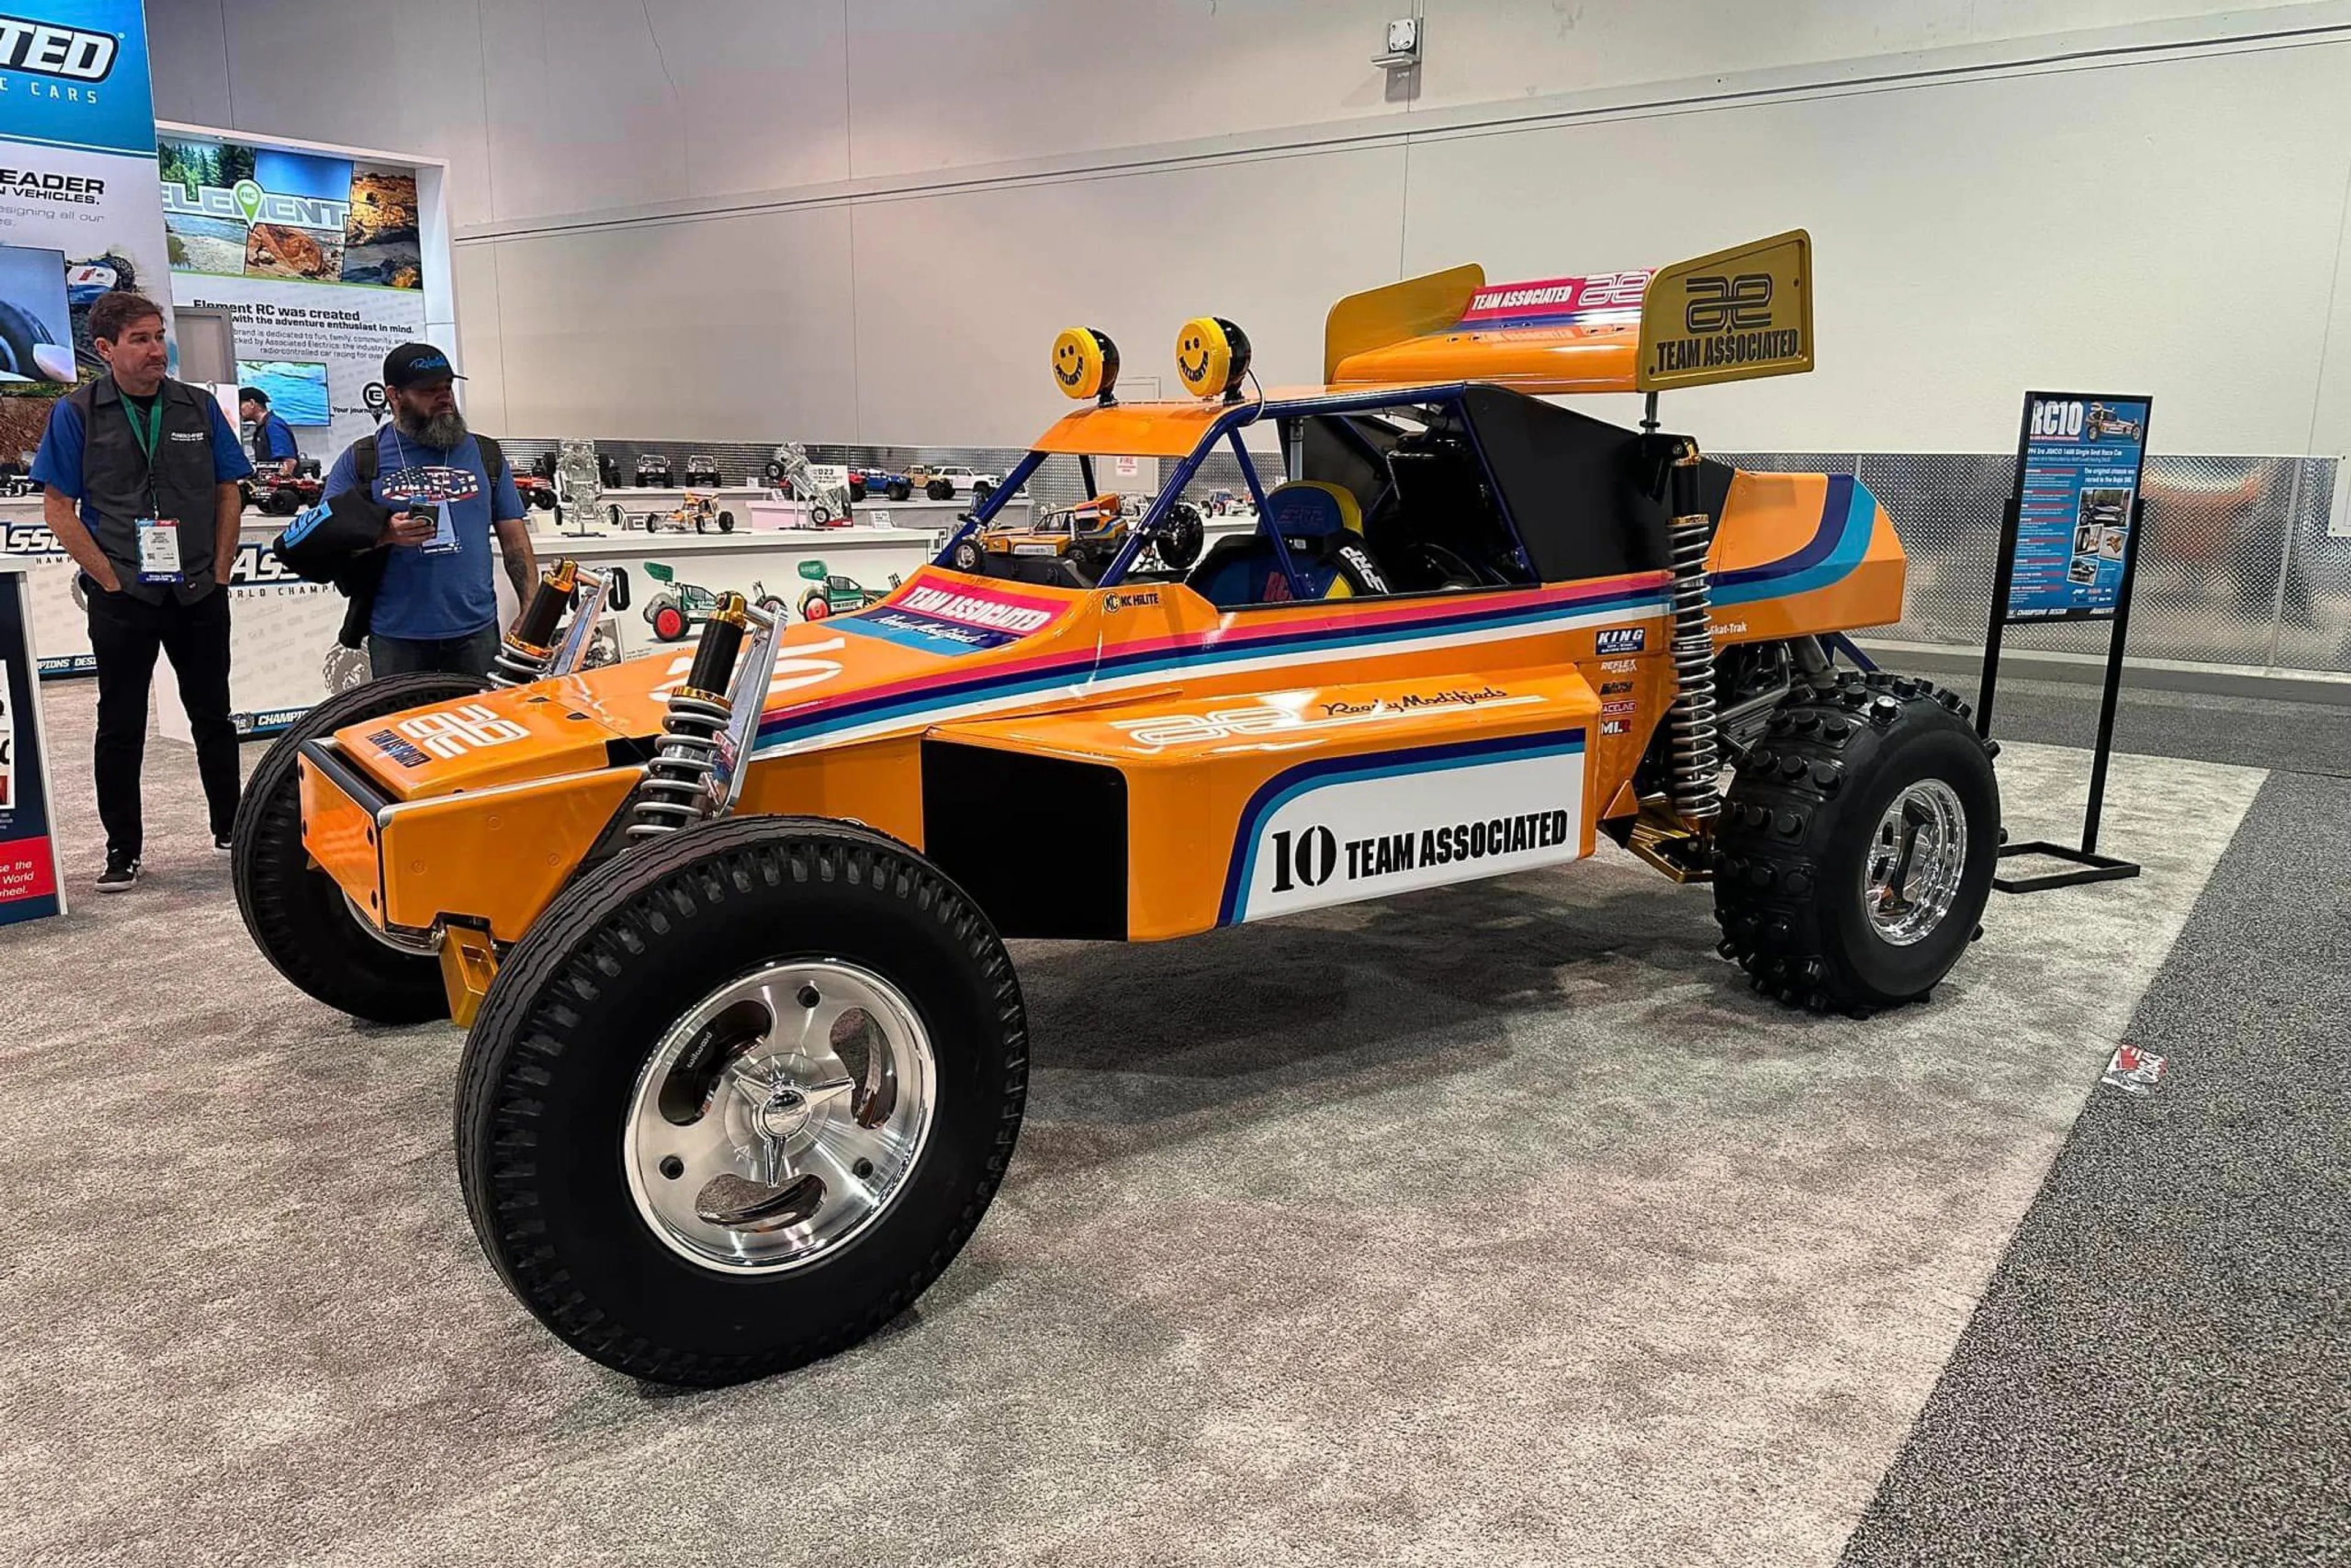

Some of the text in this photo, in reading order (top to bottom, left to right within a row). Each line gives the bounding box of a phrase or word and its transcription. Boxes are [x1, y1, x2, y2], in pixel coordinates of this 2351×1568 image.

[31, 82, 97, 103] CARS
[0, 168, 105, 195] EADER
[13, 187, 100, 205] VEHICLES.
[61, 211, 74, 220] all
[80, 214, 104, 223] our
[1471, 293, 1502, 310] TEAM
[1500, 286, 1573, 308] ASSOCIATED
[256, 304, 275, 315] RC
[278, 308, 306, 317] was
[309, 310, 360, 321] created
[232, 315, 253, 323] with
[256, 316, 272, 324] the
[276, 318, 324, 328] adventure
[327, 321, 377, 331] enthusiast
[1656, 329, 1798, 372] TEAM ASSOCIATED
[2030, 400, 2083, 436] RC10
[897, 585, 1052, 632] TEAM ASSOCIATED
[1120, 596, 1132, 607] KC
[1598, 629, 1644, 645] KING
[1600, 659, 1637, 672] REFLEX
[1403, 687, 1507, 709] Modifieds
[1272, 809, 1567, 893] 10 TEAM ASSOCIATED
[15, 861, 32, 871] the
[2, 871, 35, 884] World
[687, 1031, 713, 1068] wilwood
